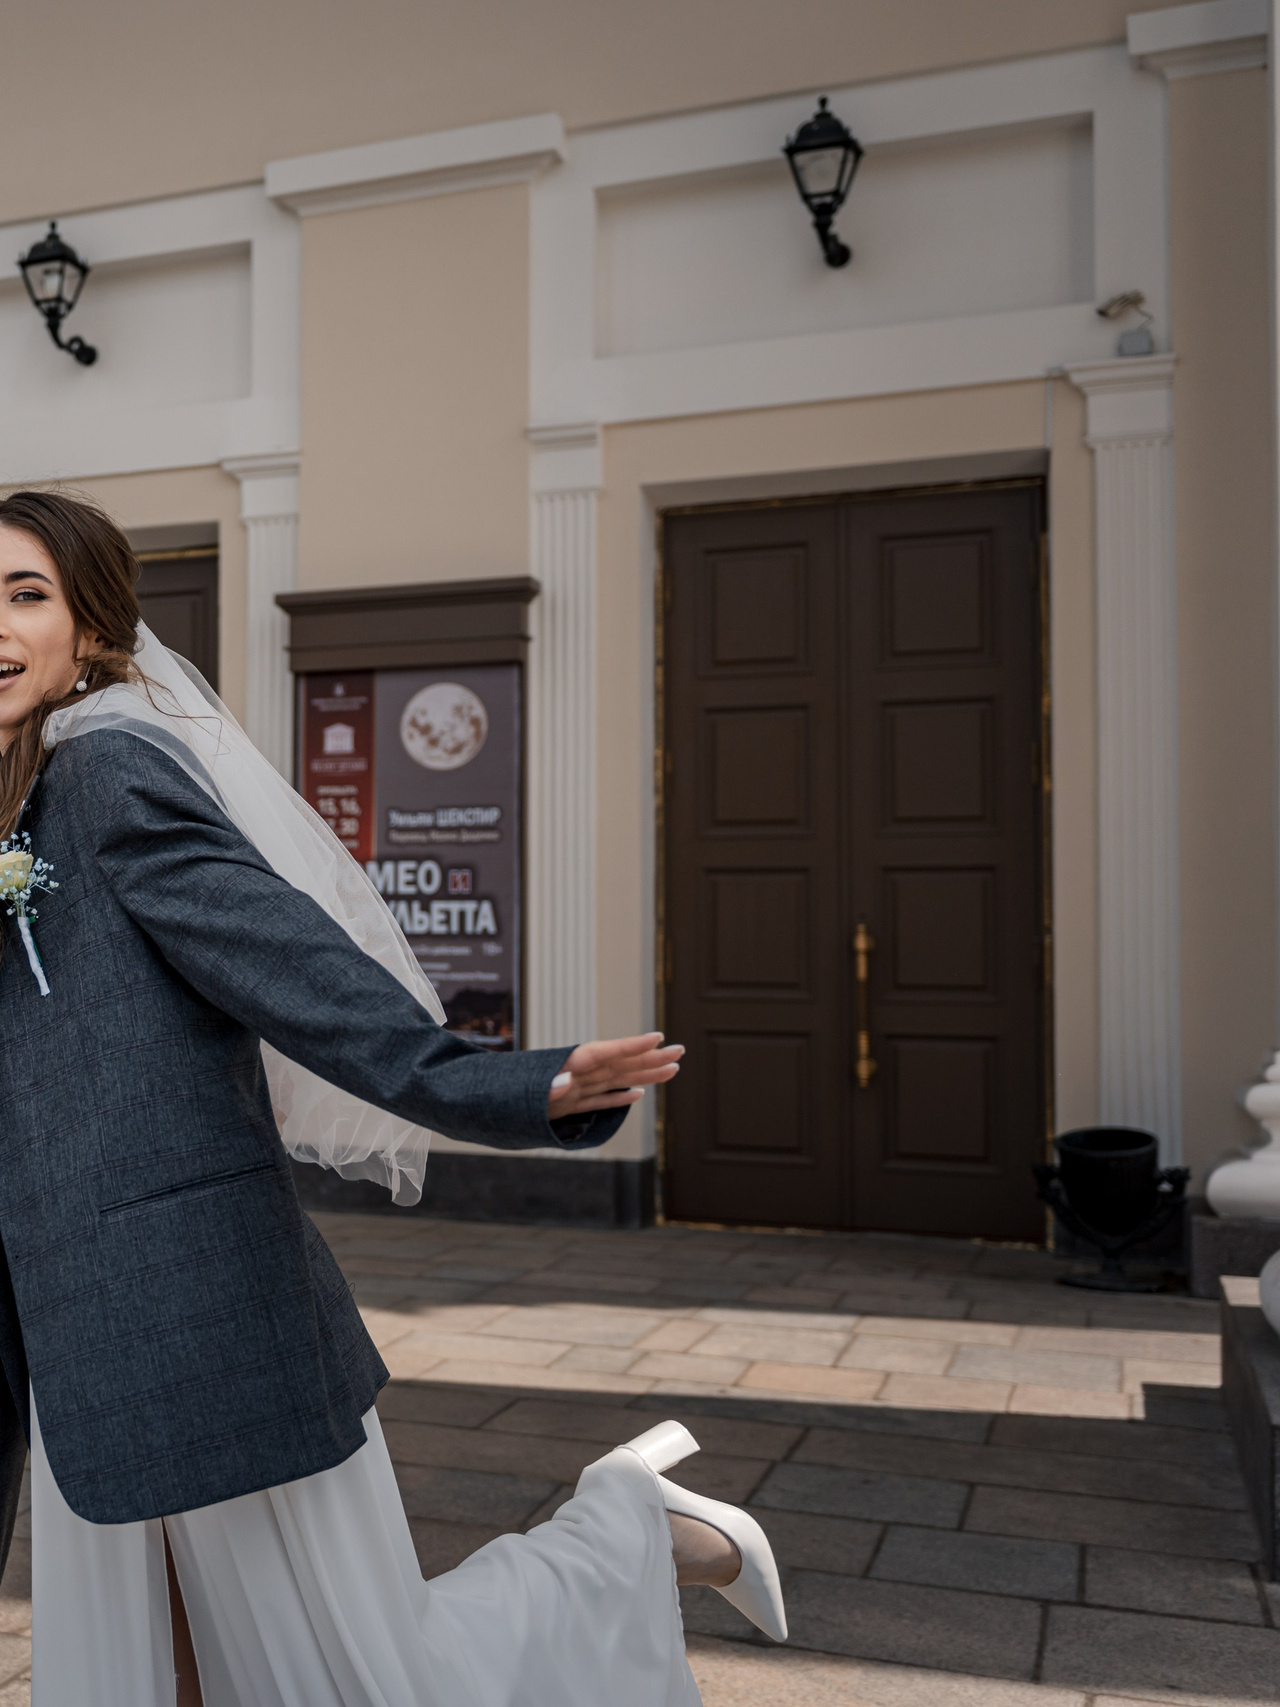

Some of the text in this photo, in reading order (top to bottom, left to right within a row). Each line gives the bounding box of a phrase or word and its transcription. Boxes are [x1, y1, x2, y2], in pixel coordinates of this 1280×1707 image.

[436, 807, 500, 826] ШЕКСПИР
[365, 860, 442, 895] МЕО
[388, 900, 497, 935] ЛЬЕТТА
